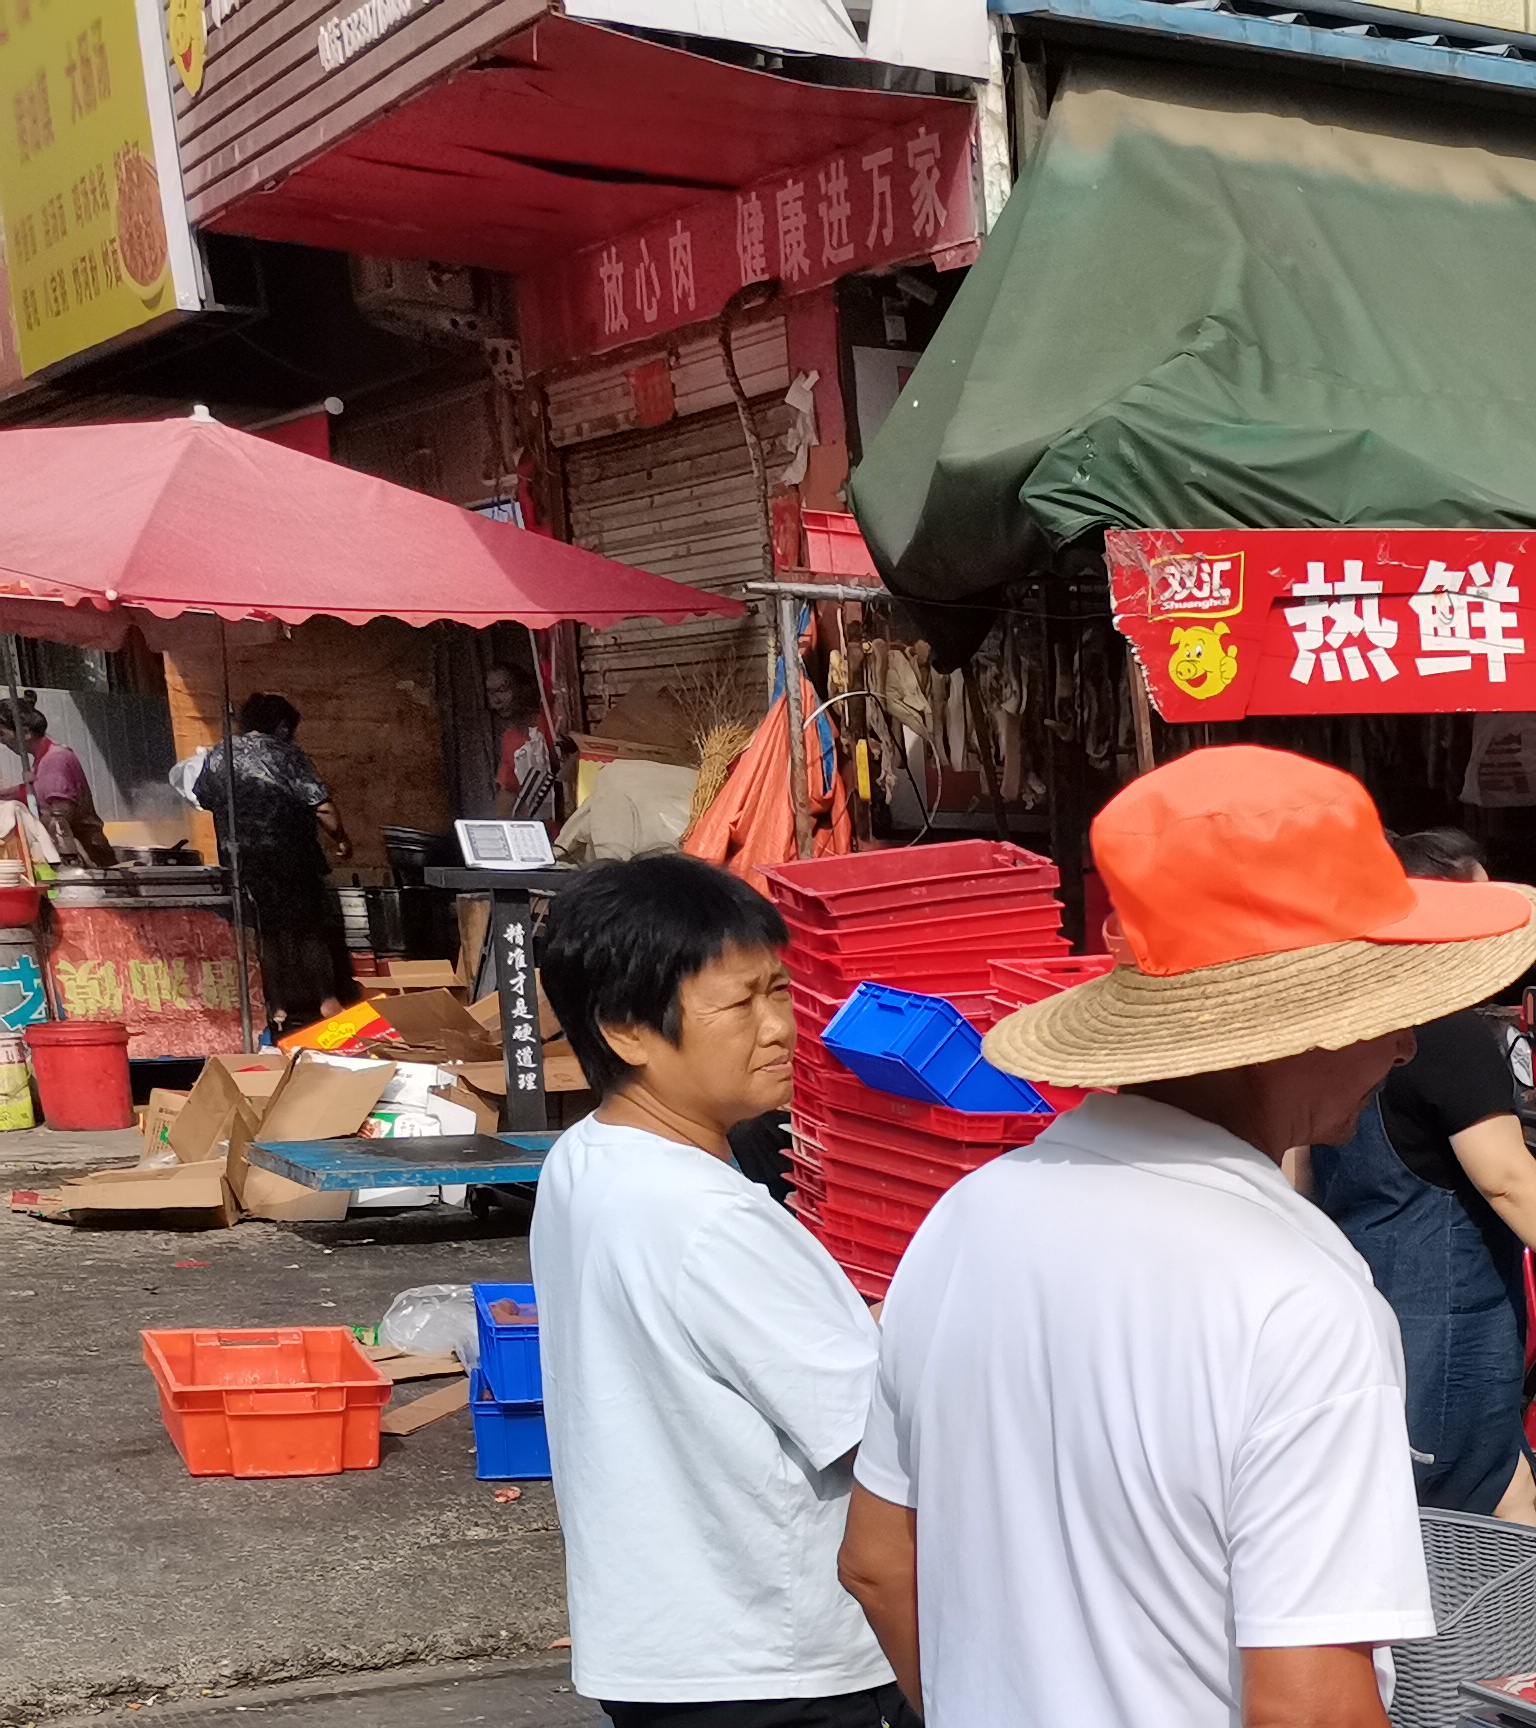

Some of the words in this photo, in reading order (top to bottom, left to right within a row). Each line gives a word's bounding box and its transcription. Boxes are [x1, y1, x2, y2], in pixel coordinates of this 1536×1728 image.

[599, 218, 696, 336] 放心肉
[736, 126, 948, 286] 健康进万家
[1160, 560, 1232, 601] 双汇
[503, 922, 538, 1091] 精准才是硬道理
